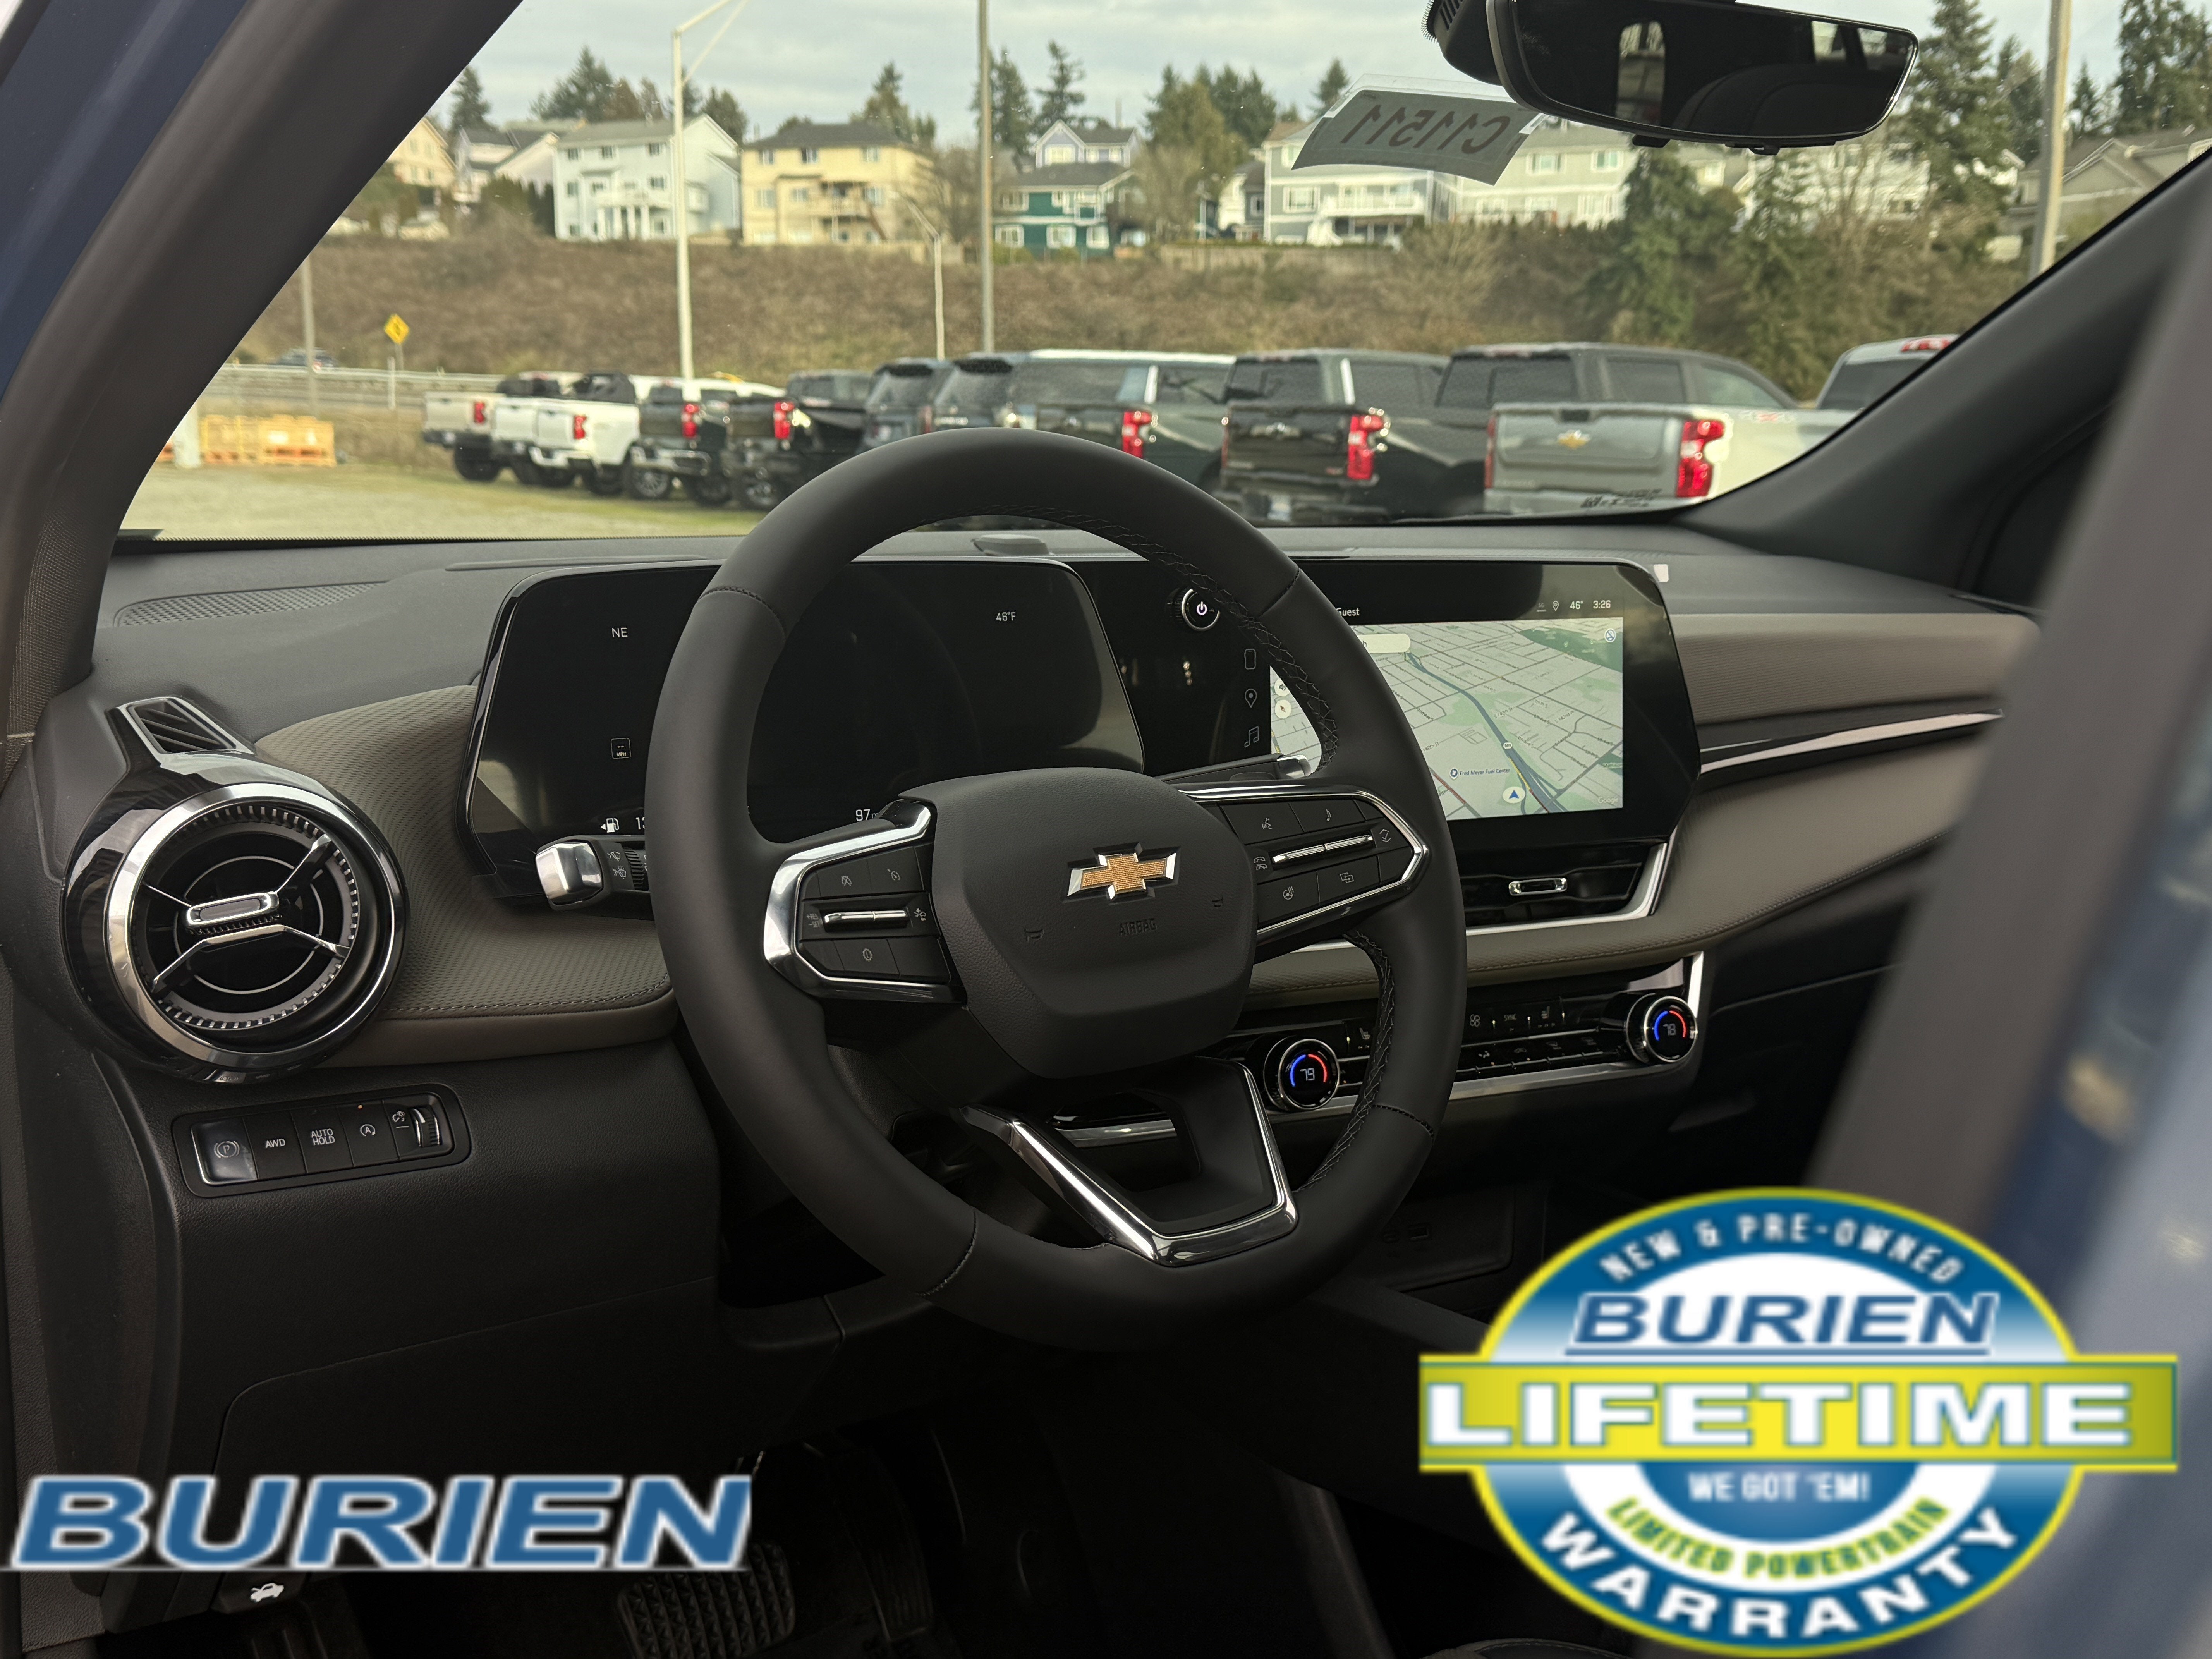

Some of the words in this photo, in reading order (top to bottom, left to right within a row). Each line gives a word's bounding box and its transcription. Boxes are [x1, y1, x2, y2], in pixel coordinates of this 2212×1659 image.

[1593, 600, 1611, 609] 3:26
[996, 611, 1016, 621] 46°F
[612, 627, 628, 638] NE
[1118, 918, 1157, 937] AIRBAG
[1504, 1013, 1517, 1022] SYNC
[311, 1128, 333, 1138] AUTO
[265, 1138, 286, 1148] AWD
[313, 1136, 335, 1146] HOLD
